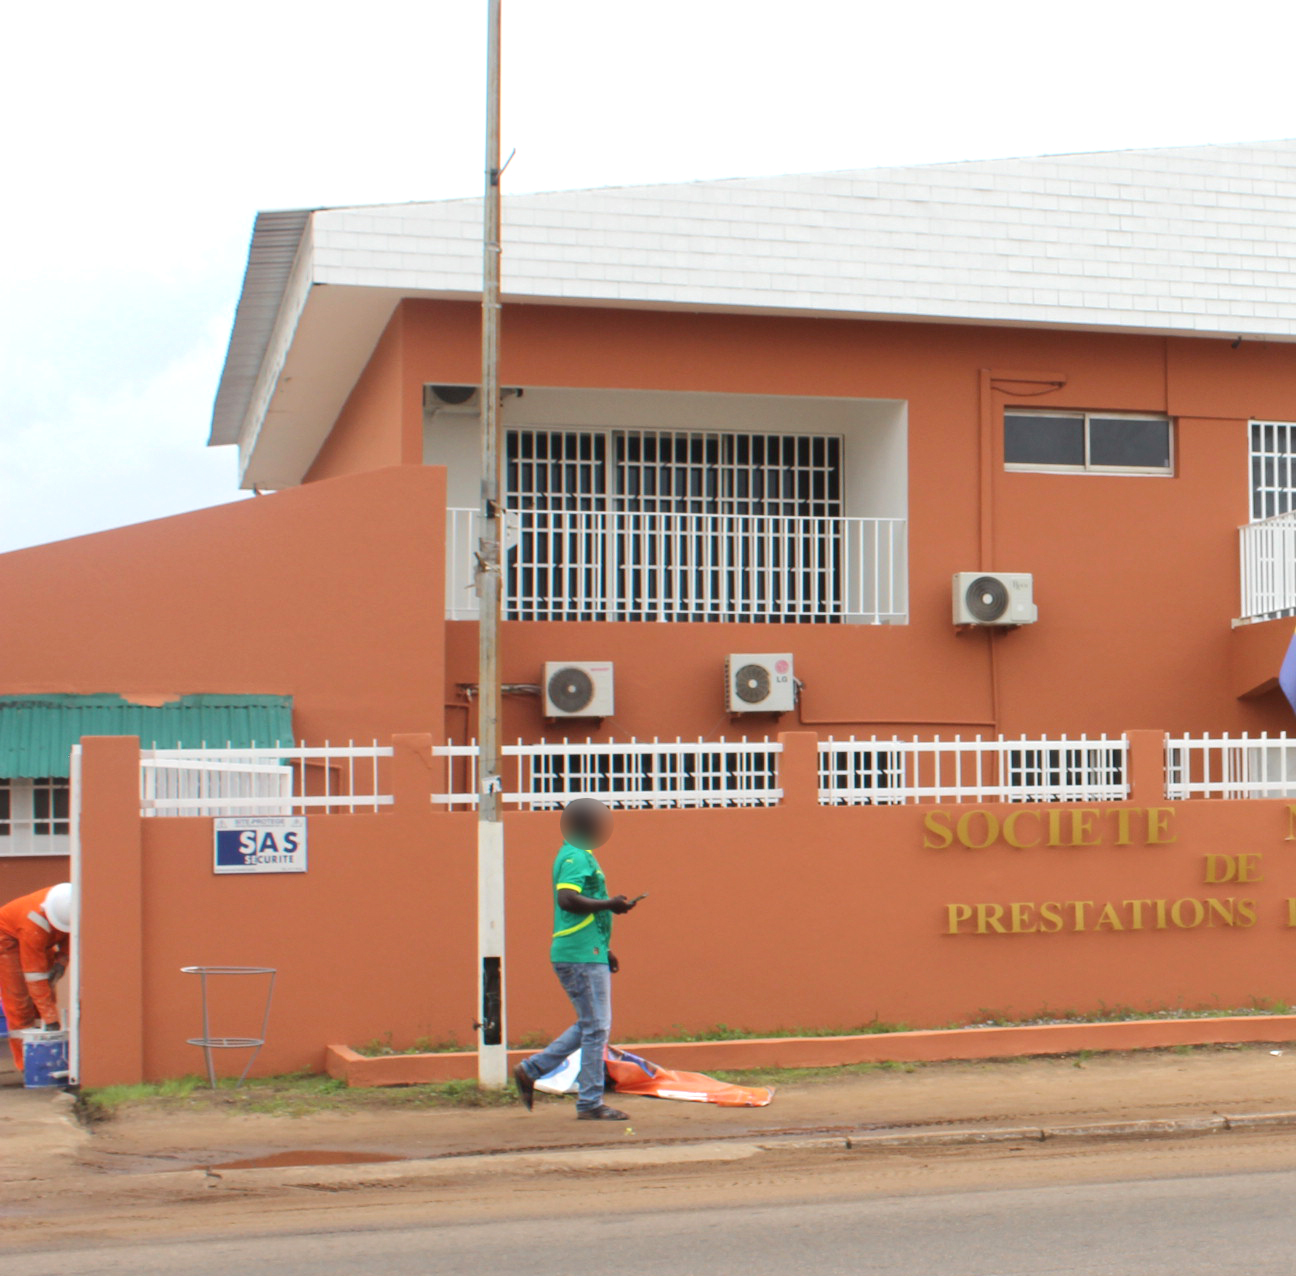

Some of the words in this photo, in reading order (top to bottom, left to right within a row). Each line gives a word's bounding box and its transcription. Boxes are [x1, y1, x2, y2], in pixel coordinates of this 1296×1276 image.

[776, 675, 788, 683] LG
[923, 806, 1178, 849] SOCIETE
[239, 831, 298, 854] SAS
[244, 855, 294, 865] SECURITE
[1203, 853, 1265, 883] DE
[944, 897, 1257, 934] PRESTATIONS
